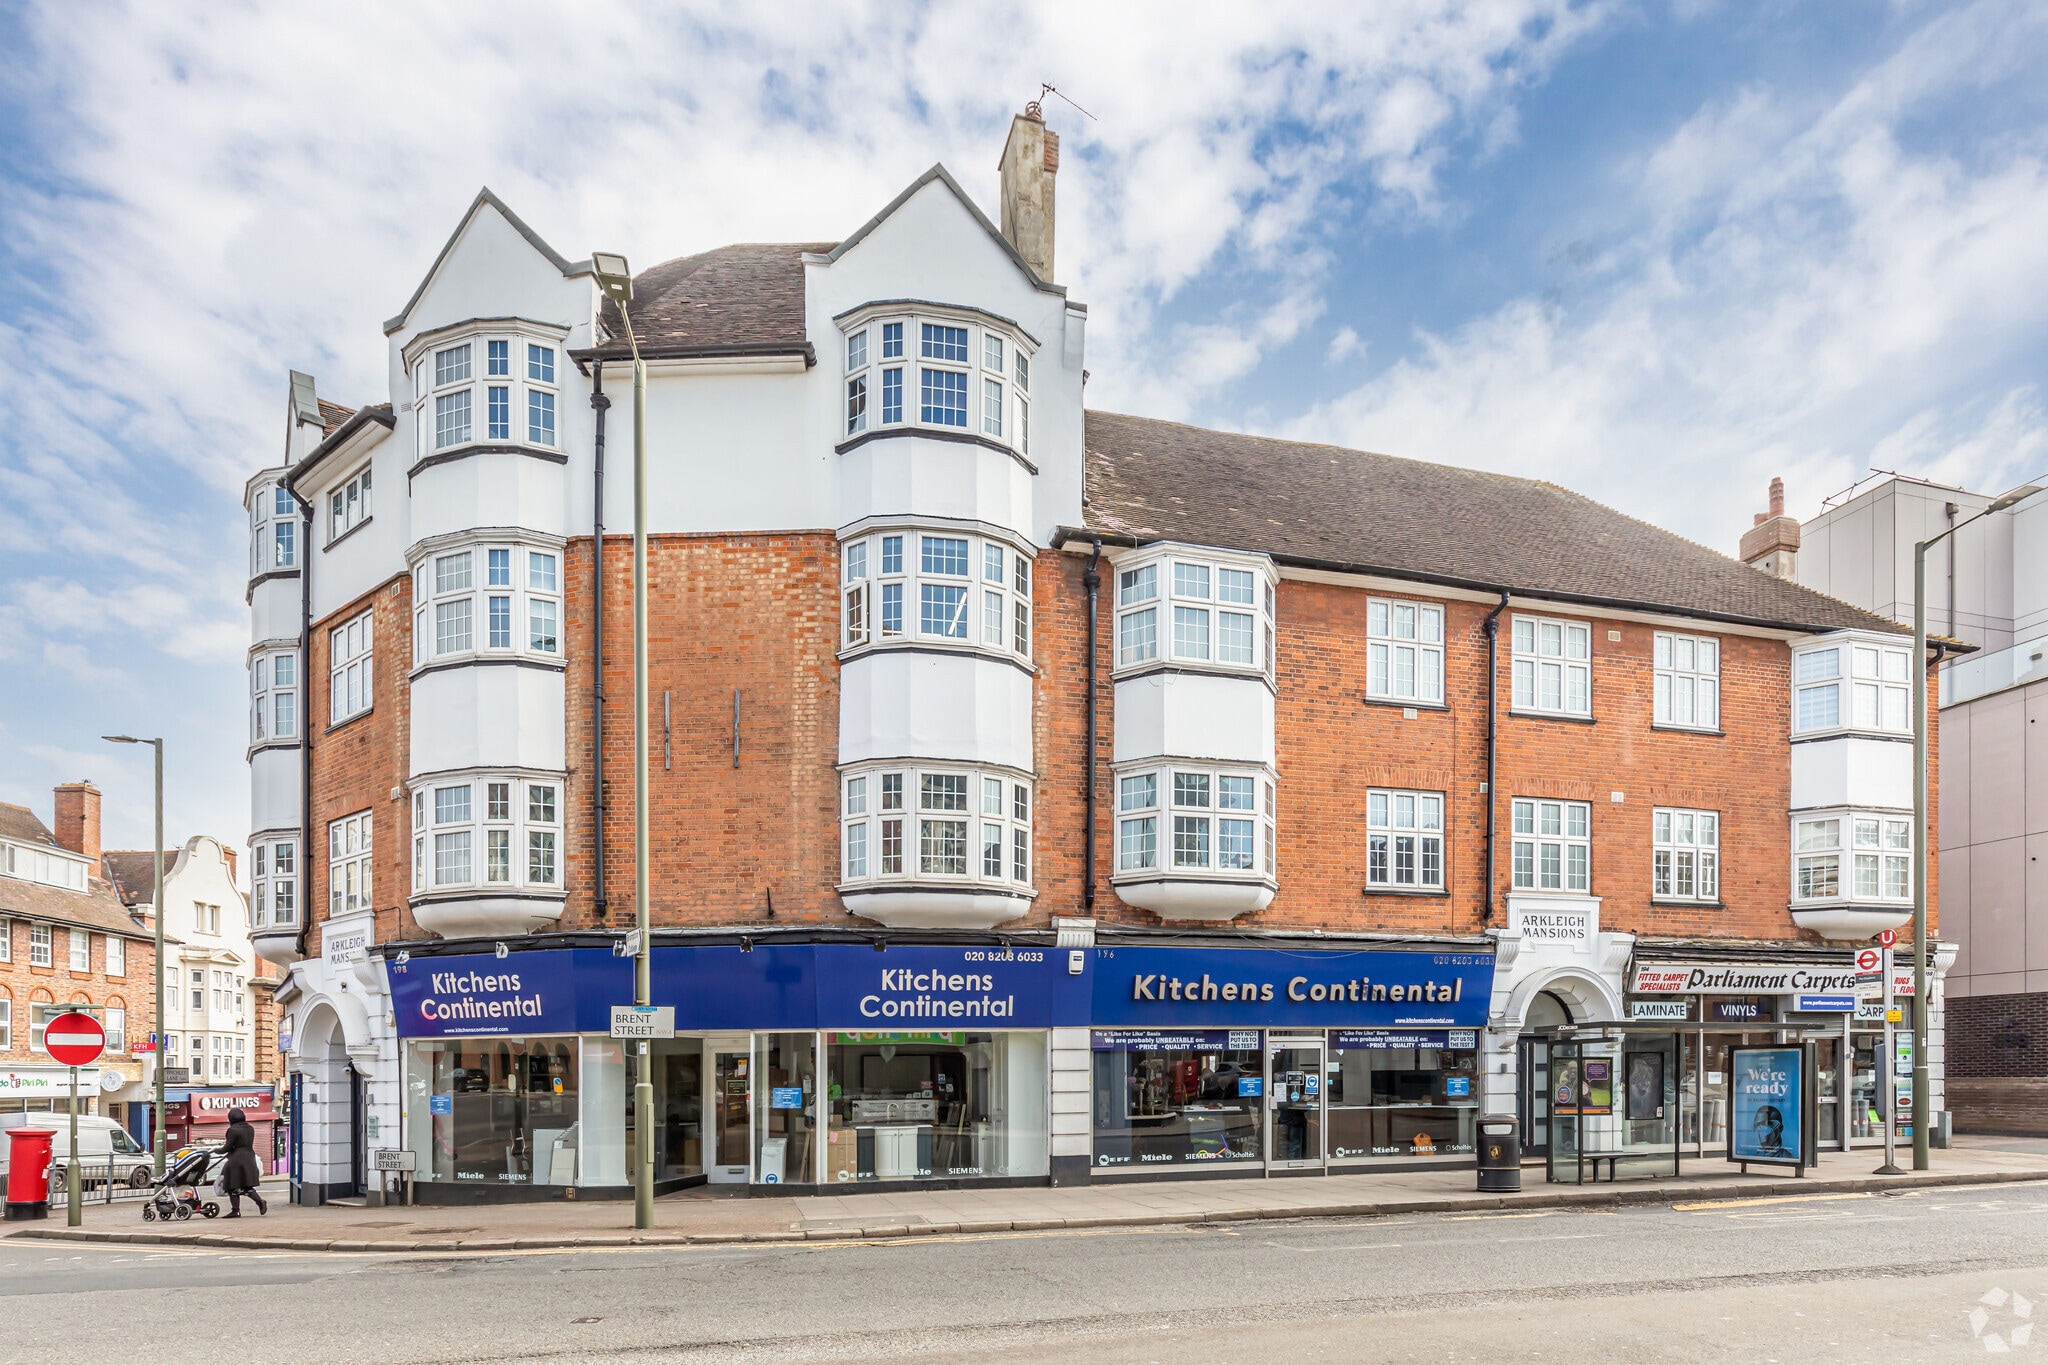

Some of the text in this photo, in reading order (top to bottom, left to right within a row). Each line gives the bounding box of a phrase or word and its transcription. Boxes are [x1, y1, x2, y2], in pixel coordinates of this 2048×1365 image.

[1522, 915, 1584, 926] ARKLEIGH
[1522, 928, 1584, 938] MANSIONS
[331, 936, 365, 952] ARKLEIGH
[964, 952, 984, 961] 020
[1017, 952, 1044, 961] 6033
[1098, 950, 1114, 958] 196
[1434, 956, 1449, 965] 020
[393, 966, 407, 974] 198
[432, 971, 521, 994] Kitchens
[882, 969, 993, 991] Kitchens
[1638, 973, 1661, 981] FITTED
[1686, 968, 1855, 992] Parliament Carpets
[1134, 974, 1462, 1002] Kitchens Continental
[420, 994, 542, 1020] Continental
[860, 995, 1014, 1017] Continental
[1633, 1004, 1685, 1016] LAMINATE
[1720, 1004, 1757, 1017] VINYLS
[616, 1014, 651, 1023] BRENT
[614, 1026, 654, 1035] STREET
[1747, 1068, 1786, 1081] We're
[1746, 1082, 1788, 1096] ready
[212, 1097, 260, 1108] KIPLINGS
